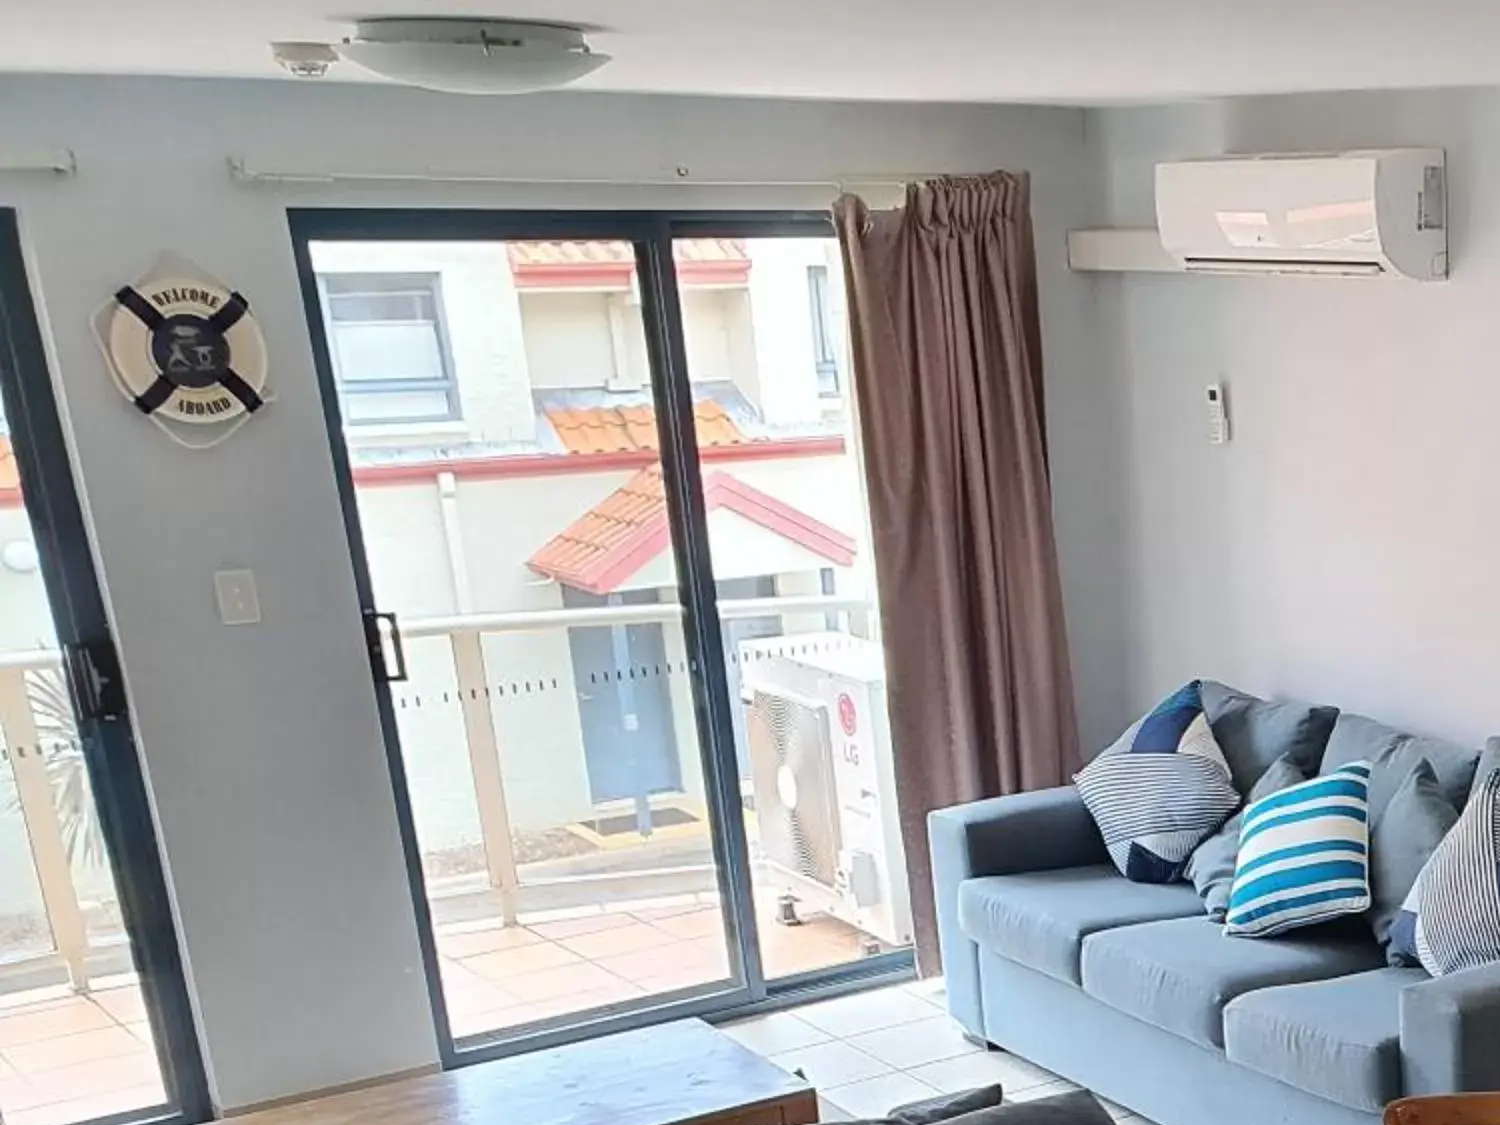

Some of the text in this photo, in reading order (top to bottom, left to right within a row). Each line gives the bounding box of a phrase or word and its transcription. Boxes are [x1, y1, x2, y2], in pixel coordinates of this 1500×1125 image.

[152, 286, 220, 308] WELCOME
[177, 397, 232, 416] ABOARD
[844, 743, 859, 766] LG
